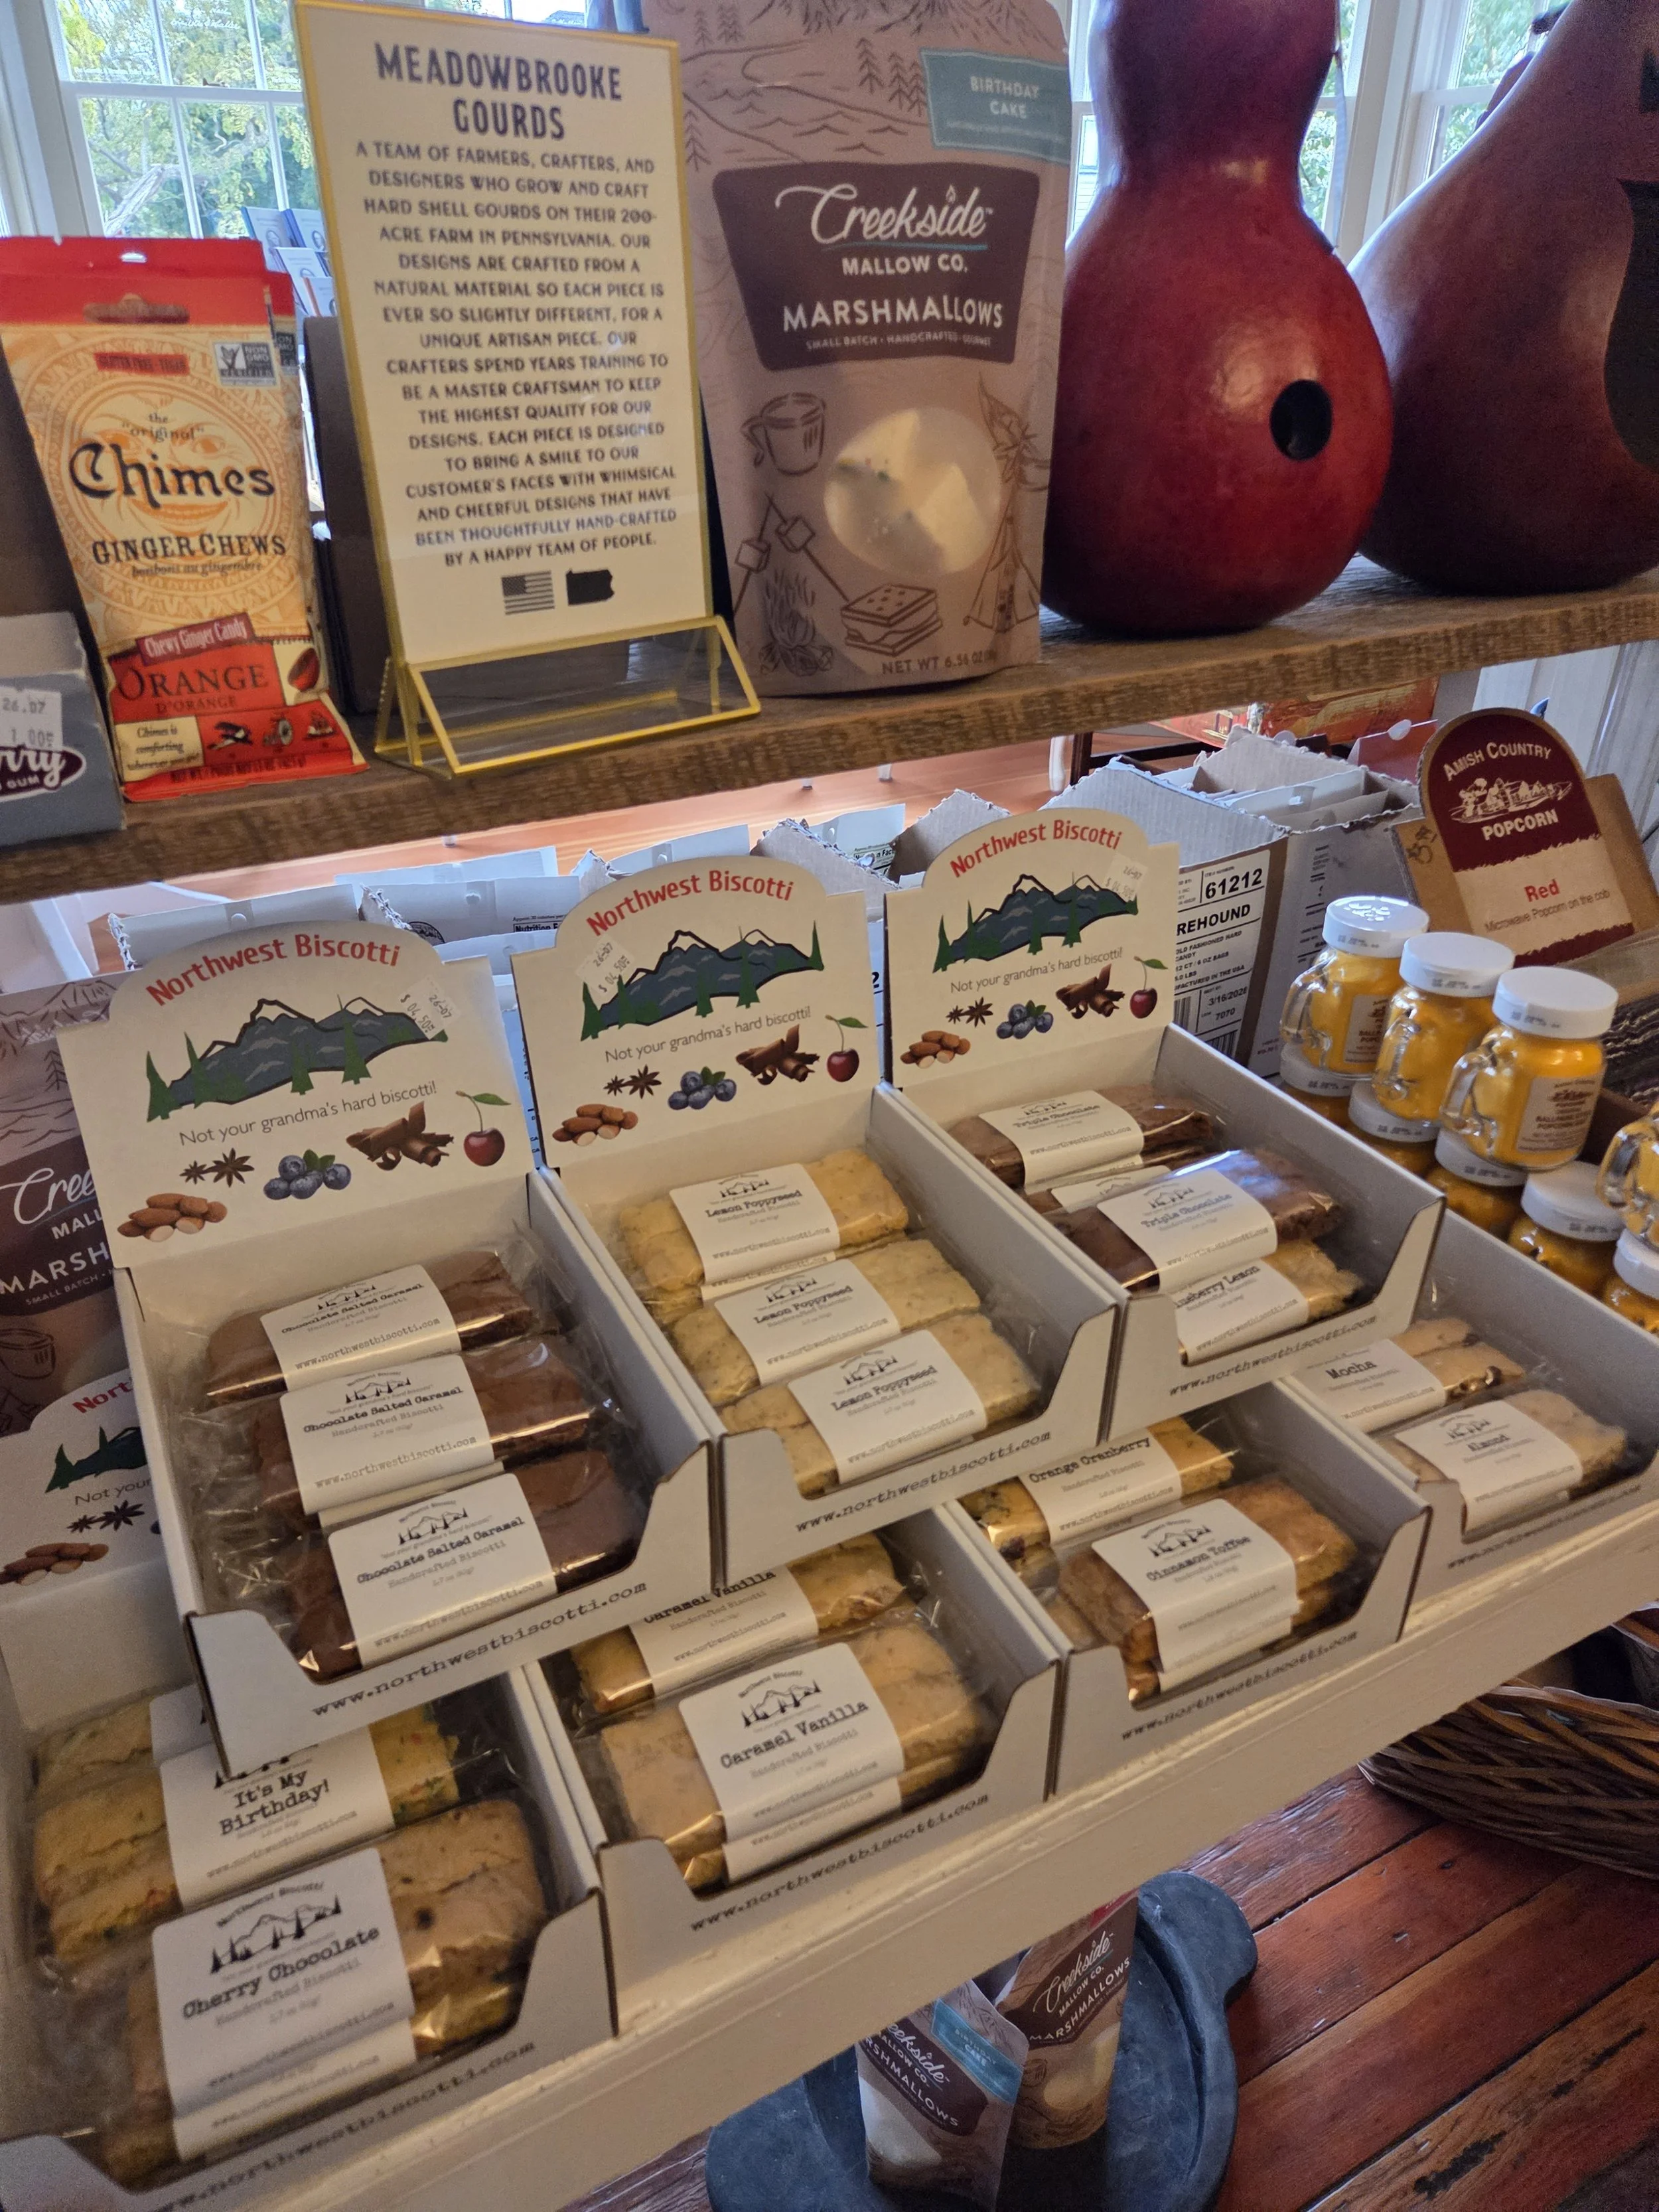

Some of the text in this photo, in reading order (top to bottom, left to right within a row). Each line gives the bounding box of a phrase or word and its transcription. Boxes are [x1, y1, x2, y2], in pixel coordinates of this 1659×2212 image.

[374, 42, 622, 101] MEADOWBROOKE
[970, 76, 1041, 99] BIRTHDAY
[453, 98, 565, 140] GOURDS
[989, 101, 1027, 119] CAKE
[357, 141, 654, 173] A TEAM OF FARMERS, CRAFTERS, AND
[369, 171, 648, 198] DESIGNERS WHO GROW AND CRAFT
[364, 199, 656, 223] HARD SHELL GOURDS ON THEIR 200-
[775, 183, 994, 245] Creekside
[380, 227, 650, 248] ACRE FARM IN PENNSYLVANIA. OUR
[399, 254, 640, 273] DESIGNS ARE CRAFTED FROM A
[842, 254, 968, 276] MALLOW CO.
[784, 295, 1003, 332] MARSHMALLOWS
[806, 339, 841, 351] SMALL
[843, 336, 877, 346] BATCH
[386, 354, 669, 375] CRAFTERS SPEND YEARS TRAINING TO
[149, 413, 169, 423] the
[418, 401, 652, 424] THE HIGHEST QUALITY FOR OUR
[70, 442, 275, 509] Chimes
[415, 509, 676, 548] BEEN THOUGHTFULLY HAND-CRAFTED
[92, 534, 286, 564] GINGER CHEWS
[143, 619, 248, 658] Chewy Ginger Candy
[118, 666, 269, 701] ORANGE
[883, 660, 911, 674] NET
[918, 656, 939, 670] WT
[155, 696, 236, 713] D'ORANGE
[1443, 742, 1551, 781] AMISH COUNTRY
[1481, 809, 1558, 840] POPCORN
[949, 819, 1123, 878] Northwest Biscotti
[586, 870, 794, 936] Northwest Biscotti
[1205, 868, 1263, 899] 61212
[1524, 879, 1559, 902] Red
[1177, 904, 1251, 936] REHOUND
[1484, 889, 1610, 932] Microwave Popcorn on the cob
[1189, 930, 1242, 950] FASHIONED HARD
[1214, 952, 1229, 960] BAGS
[145, 933, 401, 1007] Northwest Biscotti
[950, 948, 1123, 993] Not your grandma's hard biscotti!
[1232, 965, 1245, 974] USA
[605, 1007, 812, 1062] Not your grandma's hard biscotti!
[180, 1080, 438, 1146] Not your grandma's hard biscotti!
[705, 1190, 802, 1217] Lemon Poppyseed
[1140, 1194, 1232, 1228] Triple Chocolate
[0, 1242, 109, 1293] MARSH
[1222, 1266, 1260, 1285] Lemon
[26, 1274, 98, 1305] SMALL BATCH
[295, 1317, 441, 1370] www.northwestbiscotti.com
[1169, 1314, 1379, 1396] www.northwestbiscotti.com
[831, 1364, 938, 1410] Lemon Poppyseed
[1325, 1359, 1376, 1380] Mocha
[304, 1386, 464, 1433] Chocolate Salted Caramel
[332, 1404, 444, 1437] Handcrafted Biscotti
[1029, 1437, 1150, 1483] Orange Cranberry
[75, 1478, 151, 1505] Not your
[795, 1431, 1052, 1533] www.northwestbiscotti.com
[357, 1517, 525, 1584] Chocolate Salted Caramel
[1146, 1536, 1252, 1581] Cinnamon Toffee
[312, 1583, 647, 1718] www.northwestbiscotti.com
[1120, 1631, 1360, 1741] www.northwestbiscotti.com
[720, 1701, 869, 1769] Caramel Vanilla
[219, 1779, 330, 1835] Birthday!
[234, 1769, 307, 1808] It's My
[691, 1793, 989, 1931] www.northwestbiscotti.com
[182, 1926, 380, 2019] Cherry Chocolate
[1033, 1930, 1114, 2013] Creekside
[1029, 1956, 1130, 2040] MARSHMALLOWS
[1058, 1967, 1104, 2017] MALLOW CO.
[965, 2043, 987, 2066] CAKE
[866, 2037, 958, 2126] RSHMALLOWS
